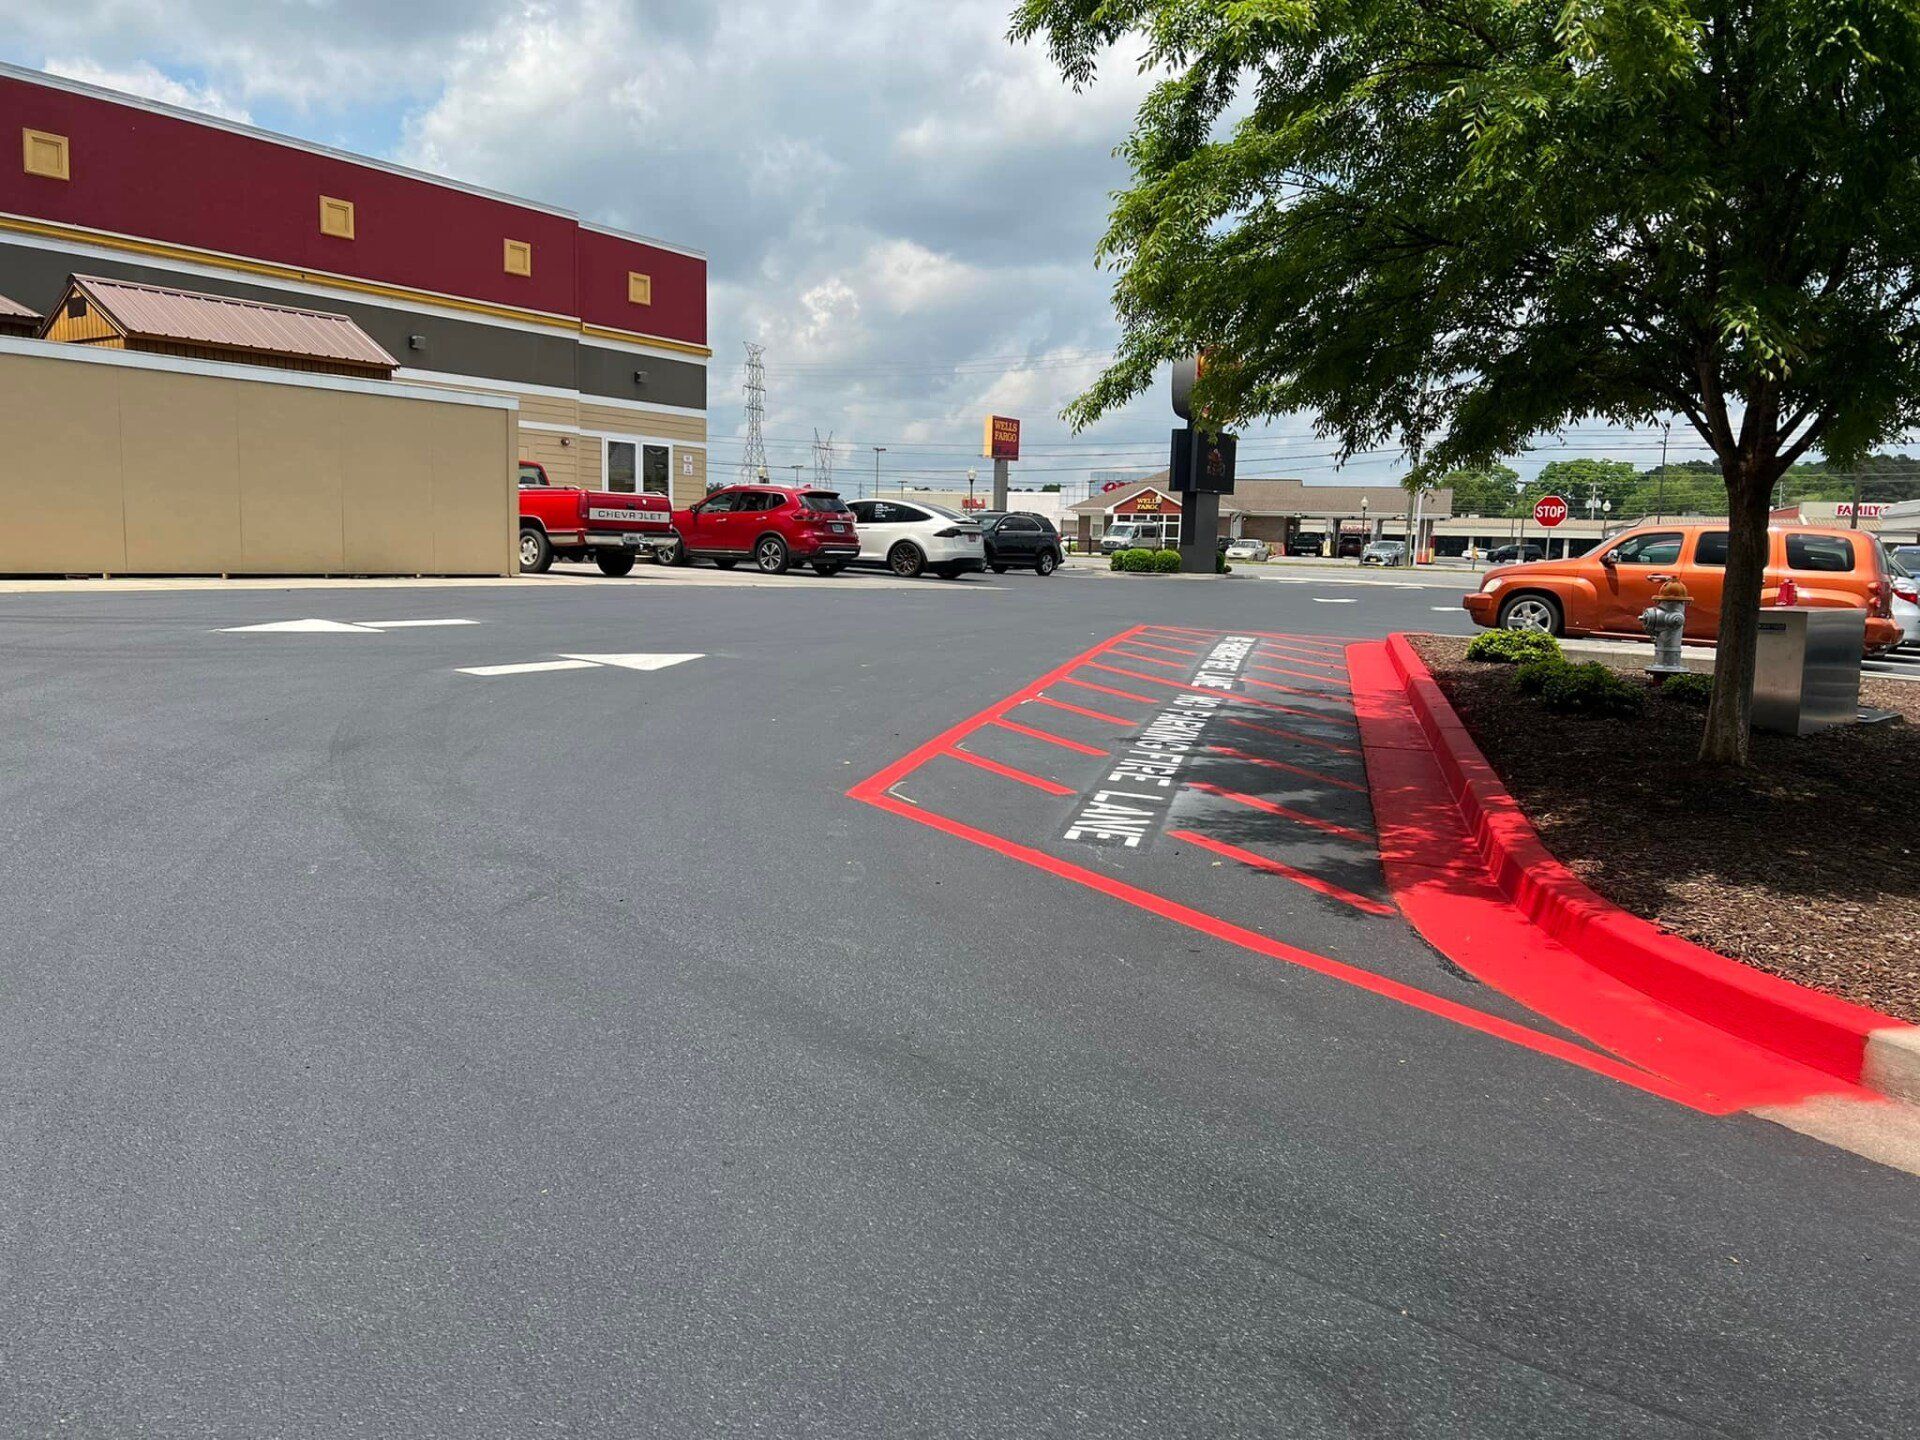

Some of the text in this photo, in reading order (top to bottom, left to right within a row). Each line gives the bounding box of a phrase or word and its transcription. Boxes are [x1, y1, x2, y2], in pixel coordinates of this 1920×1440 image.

[995, 420, 1018, 432] WELLS
[995, 431, 1017, 442] FARGO
[1536, 506, 1565, 518] STOP
[1064, 694, 1223, 847] NO PARKING FIRE LANE
